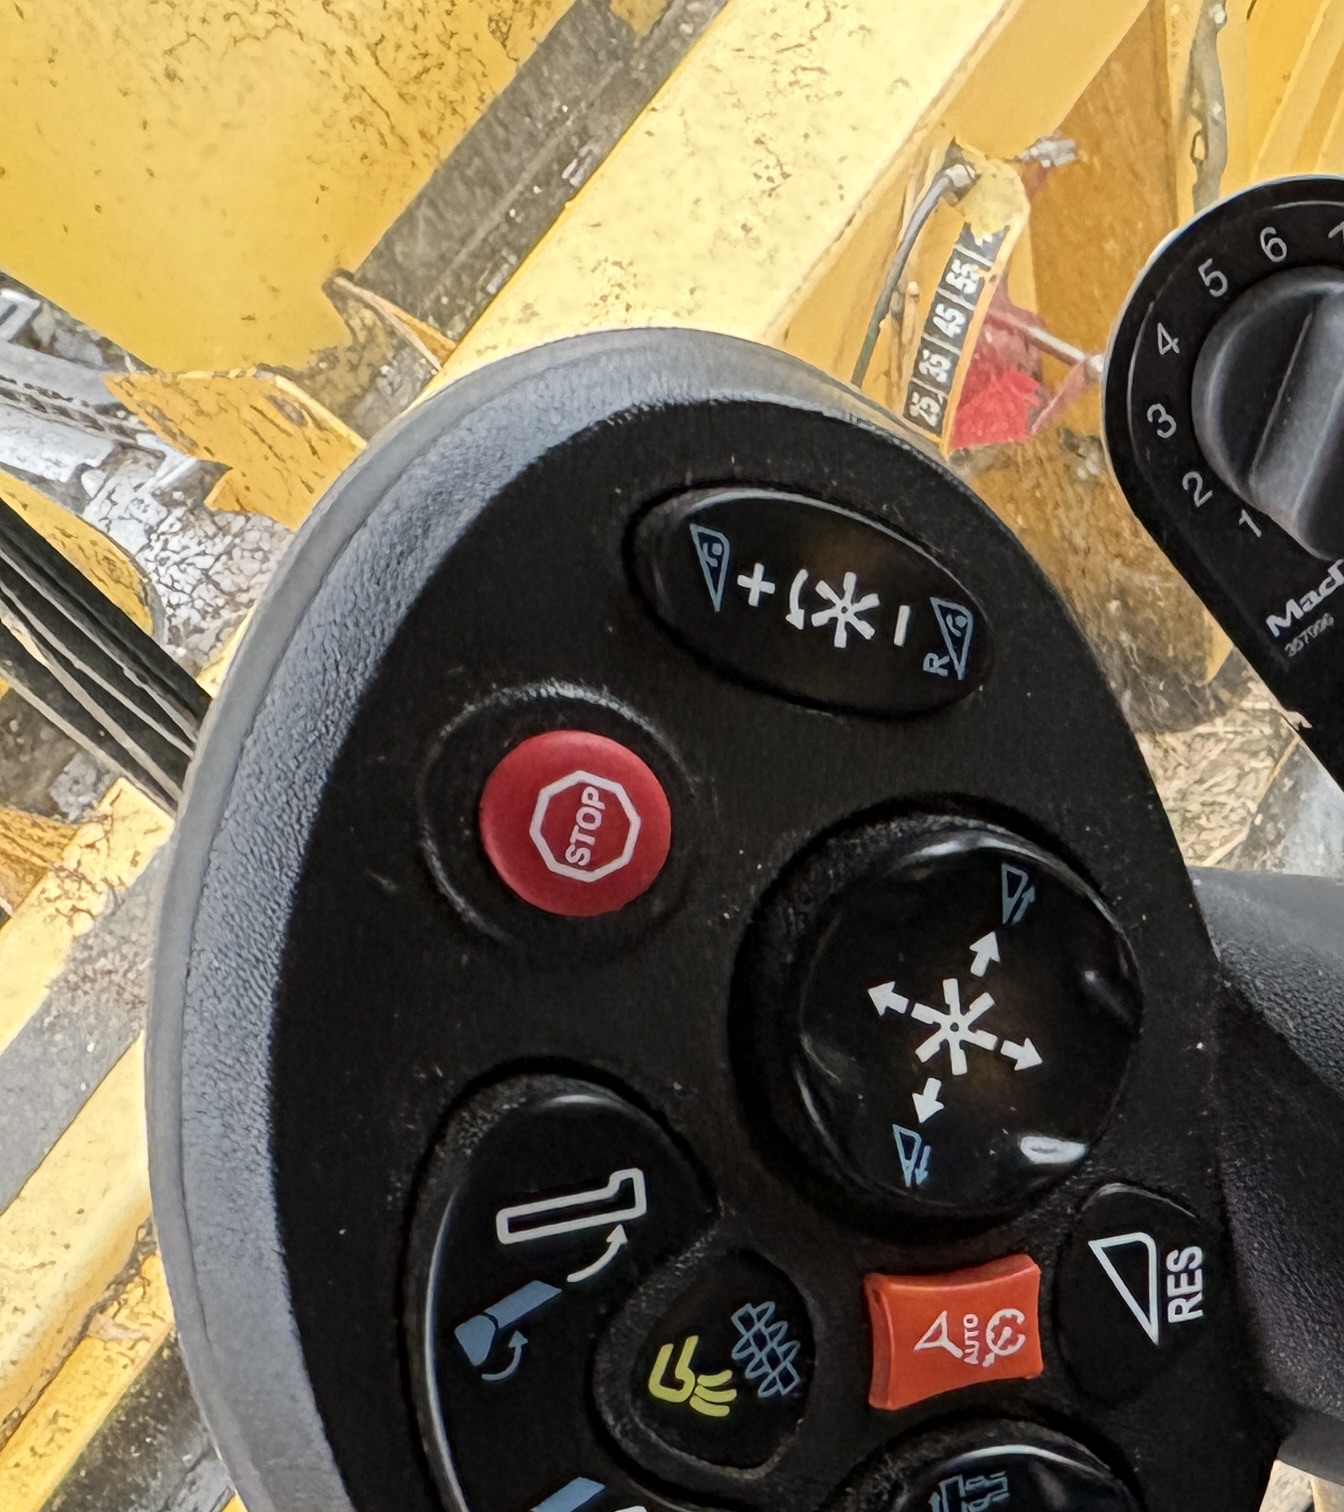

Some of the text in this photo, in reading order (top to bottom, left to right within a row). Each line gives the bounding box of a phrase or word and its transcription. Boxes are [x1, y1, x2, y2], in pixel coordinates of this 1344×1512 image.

[1259, 226, 1288, 262] 6
[945, 258, 981, 295] 55
[1198, 258, 1228, 297] 5
[932, 302, 967, 338] 45
[1156, 322, 1181, 355] 4
[1147, 403, 1177, 439] 3
[1182, 470, 1213, 507] 2
[1238, 508, 1262, 538] 1
[922, 652, 951, 677] R
[564, 785, 607, 867] STOP
[1165, 1244, 1205, 1325] RES
[962, 1312, 980, 1366] AUTO
